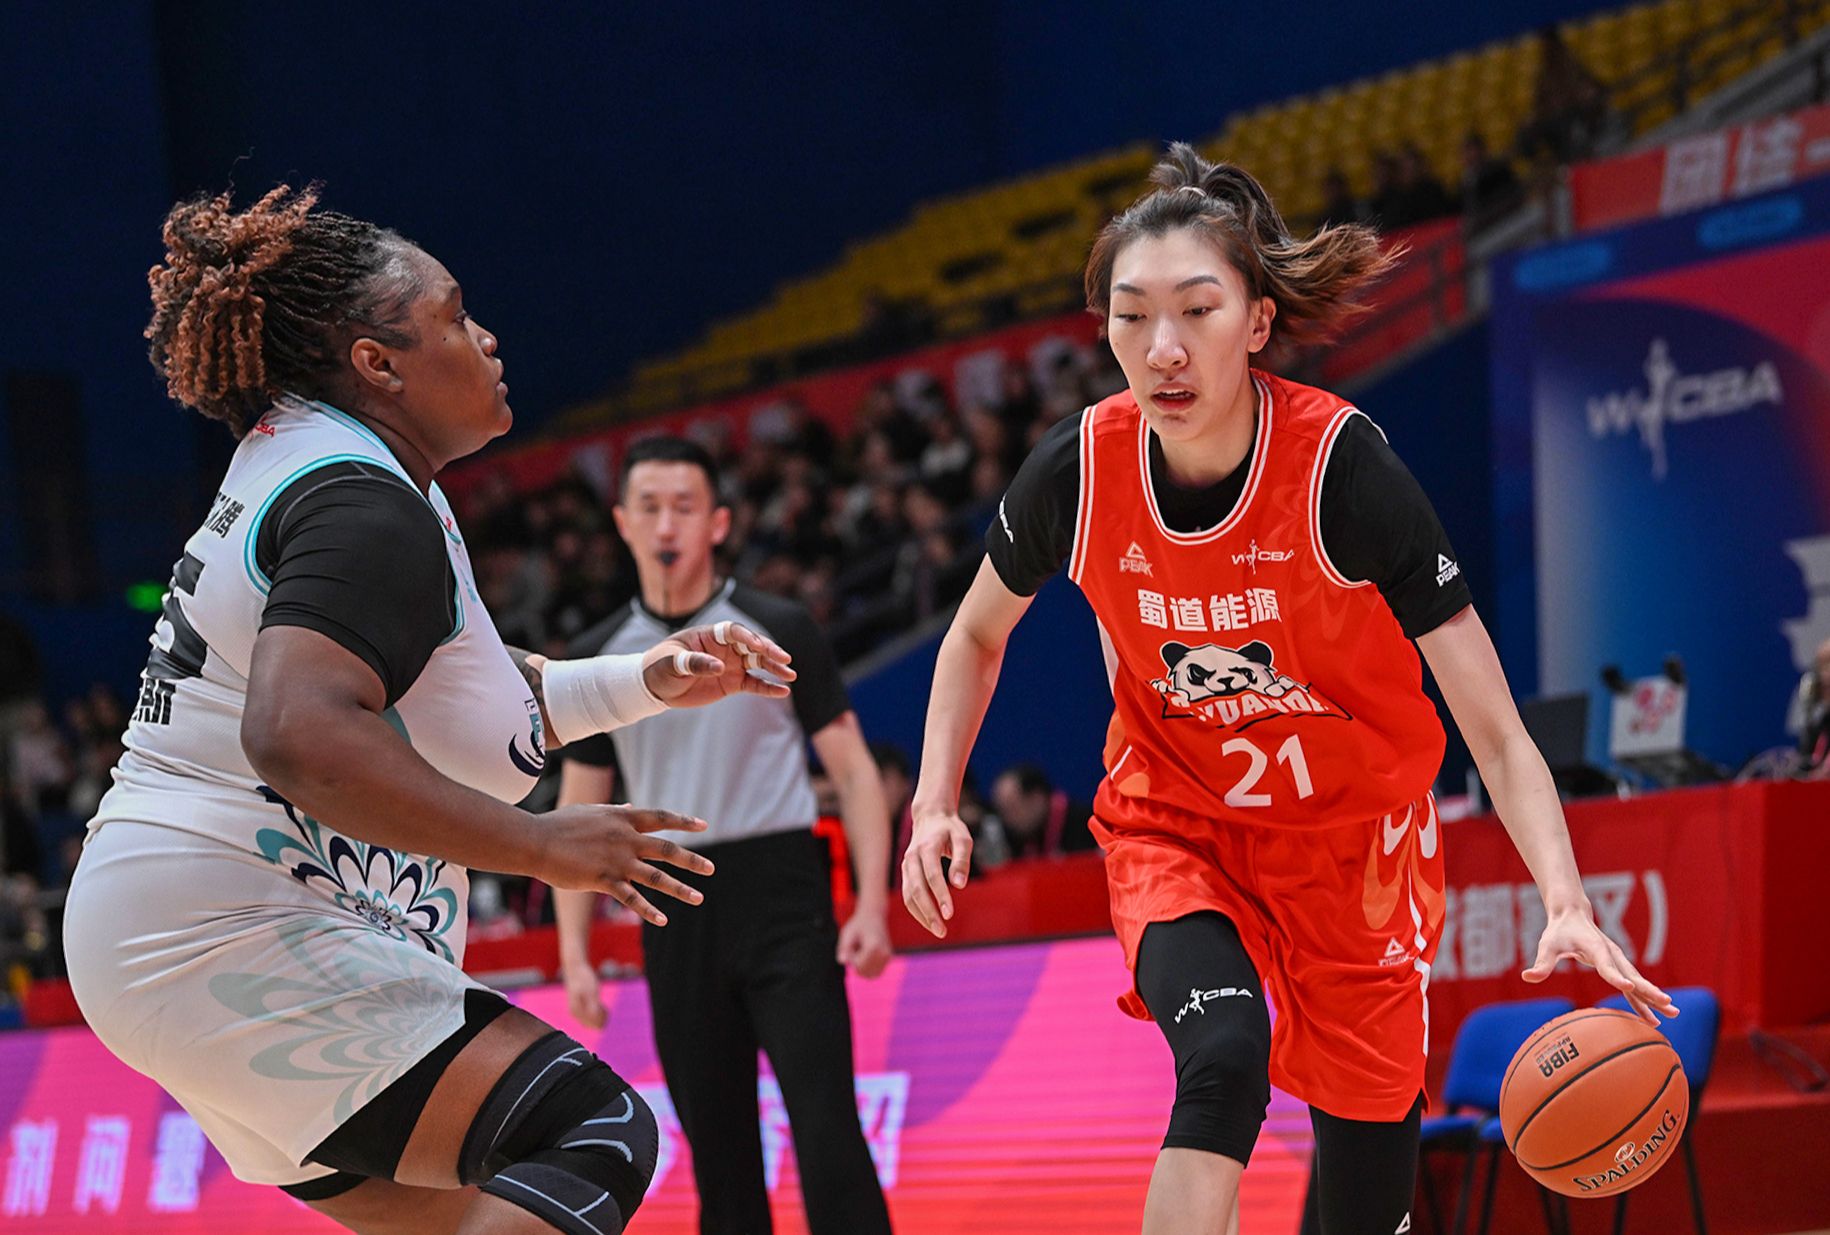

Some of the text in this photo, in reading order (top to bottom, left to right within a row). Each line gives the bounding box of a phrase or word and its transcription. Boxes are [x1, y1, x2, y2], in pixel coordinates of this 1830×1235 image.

[1119, 556, 1154, 578] PEAK
[1435, 560, 1460, 588] PEAK
[1137, 587, 1283, 633] 蜀道能源
[1221, 733, 1315, 809] 21
[1539, 1042, 1580, 1078] FIBA
[1572, 1108, 1678, 1193] SPALDING
